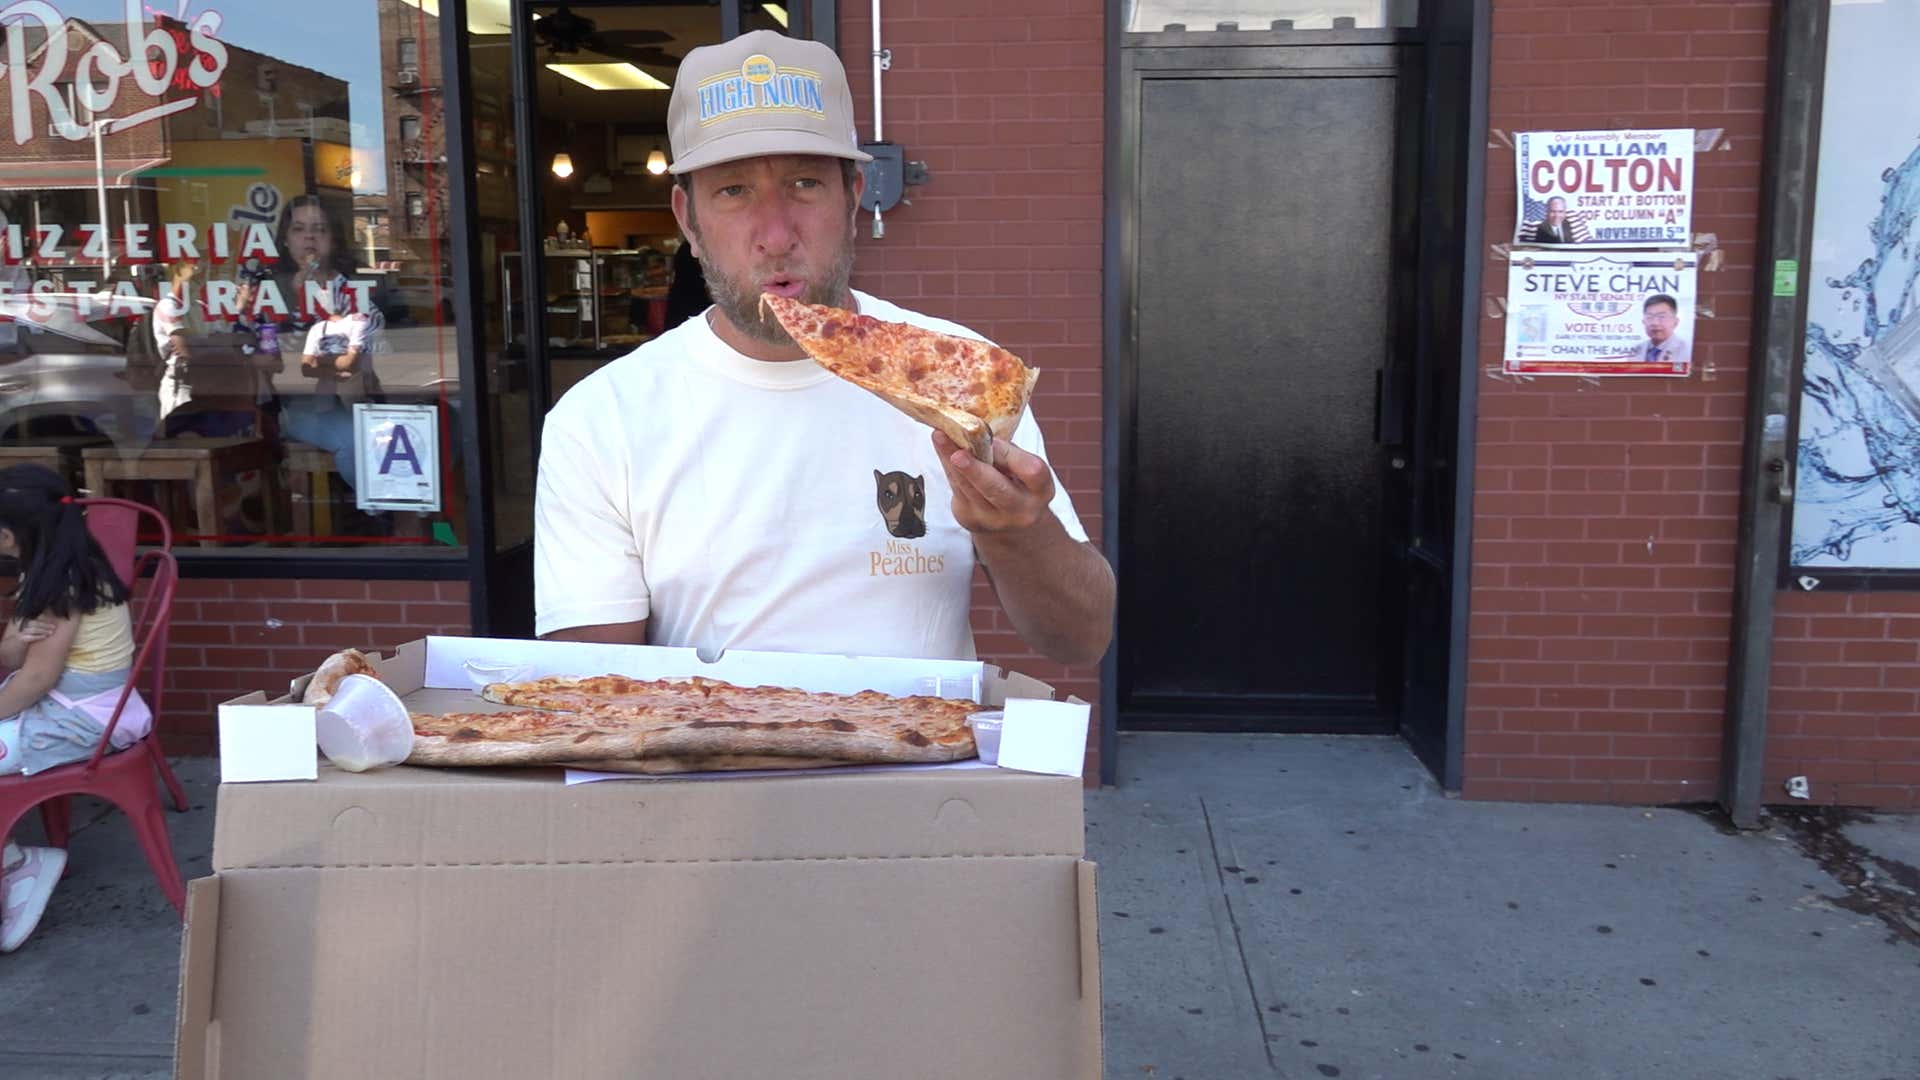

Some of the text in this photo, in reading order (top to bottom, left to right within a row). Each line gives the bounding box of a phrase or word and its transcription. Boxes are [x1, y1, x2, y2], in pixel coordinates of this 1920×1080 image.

[0, 0, 229, 146] Rob's
[697, 74, 825, 121] HIGH NOON
[1547, 142, 1667, 157] WILLIAM
[1531, 158, 1682, 194] COLTON
[1577, 194, 1686, 207] START AT BOTTOM
[1586, 209, 1601, 221] OF
[1604, 209, 1654, 220] COLUMN
[1595, 226, 1664, 240] NOVEMBER
[1524, 273, 1680, 293] STEVE CHAN
[1570, 293, 1597, 301] STATE
[1599, 293, 1634, 301] SENATE
[1565, 323, 1633, 333] VOTE 11/05
[1551, 345, 1584, 355] CHAN
[1587, 345, 1610, 355] THE
[378, 424, 423, 475] A
[886, 540, 912, 554] Miss
[869, 547, 944, 577] Peaches
